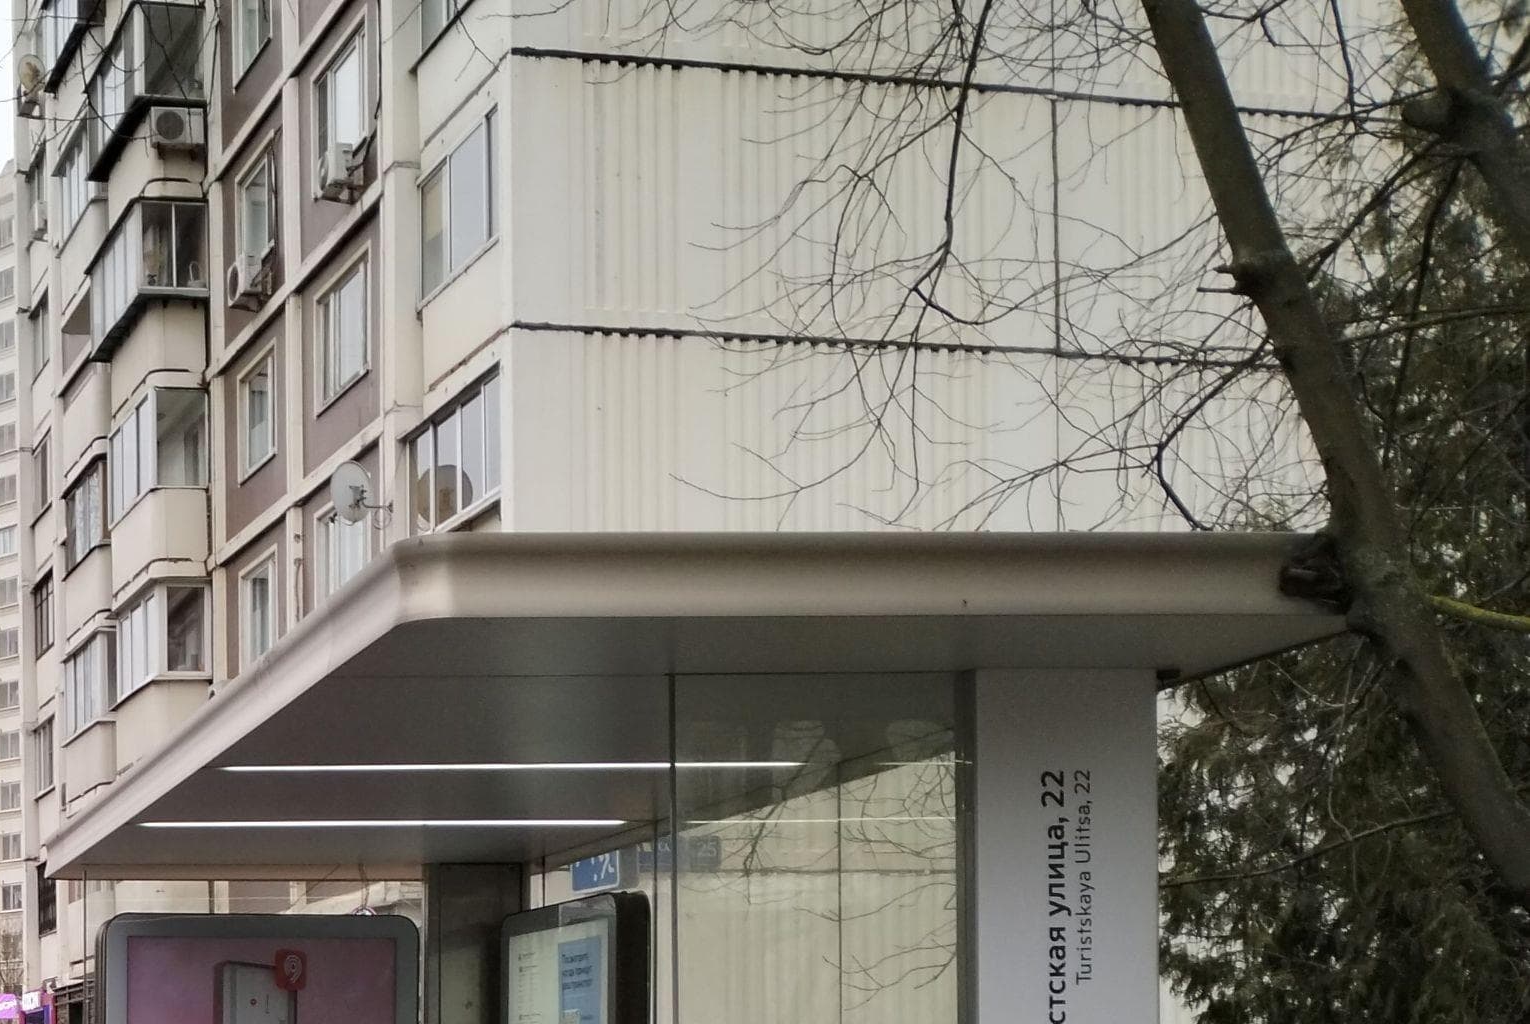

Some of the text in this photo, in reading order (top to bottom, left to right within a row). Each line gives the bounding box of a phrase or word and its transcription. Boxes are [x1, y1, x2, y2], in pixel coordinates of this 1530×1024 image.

[1041, 769, 1066, 808] 22
[1044, 817, 1071, 917] улица,
[1074, 768, 1095, 985] Turistskaya Ulitsa, 22
